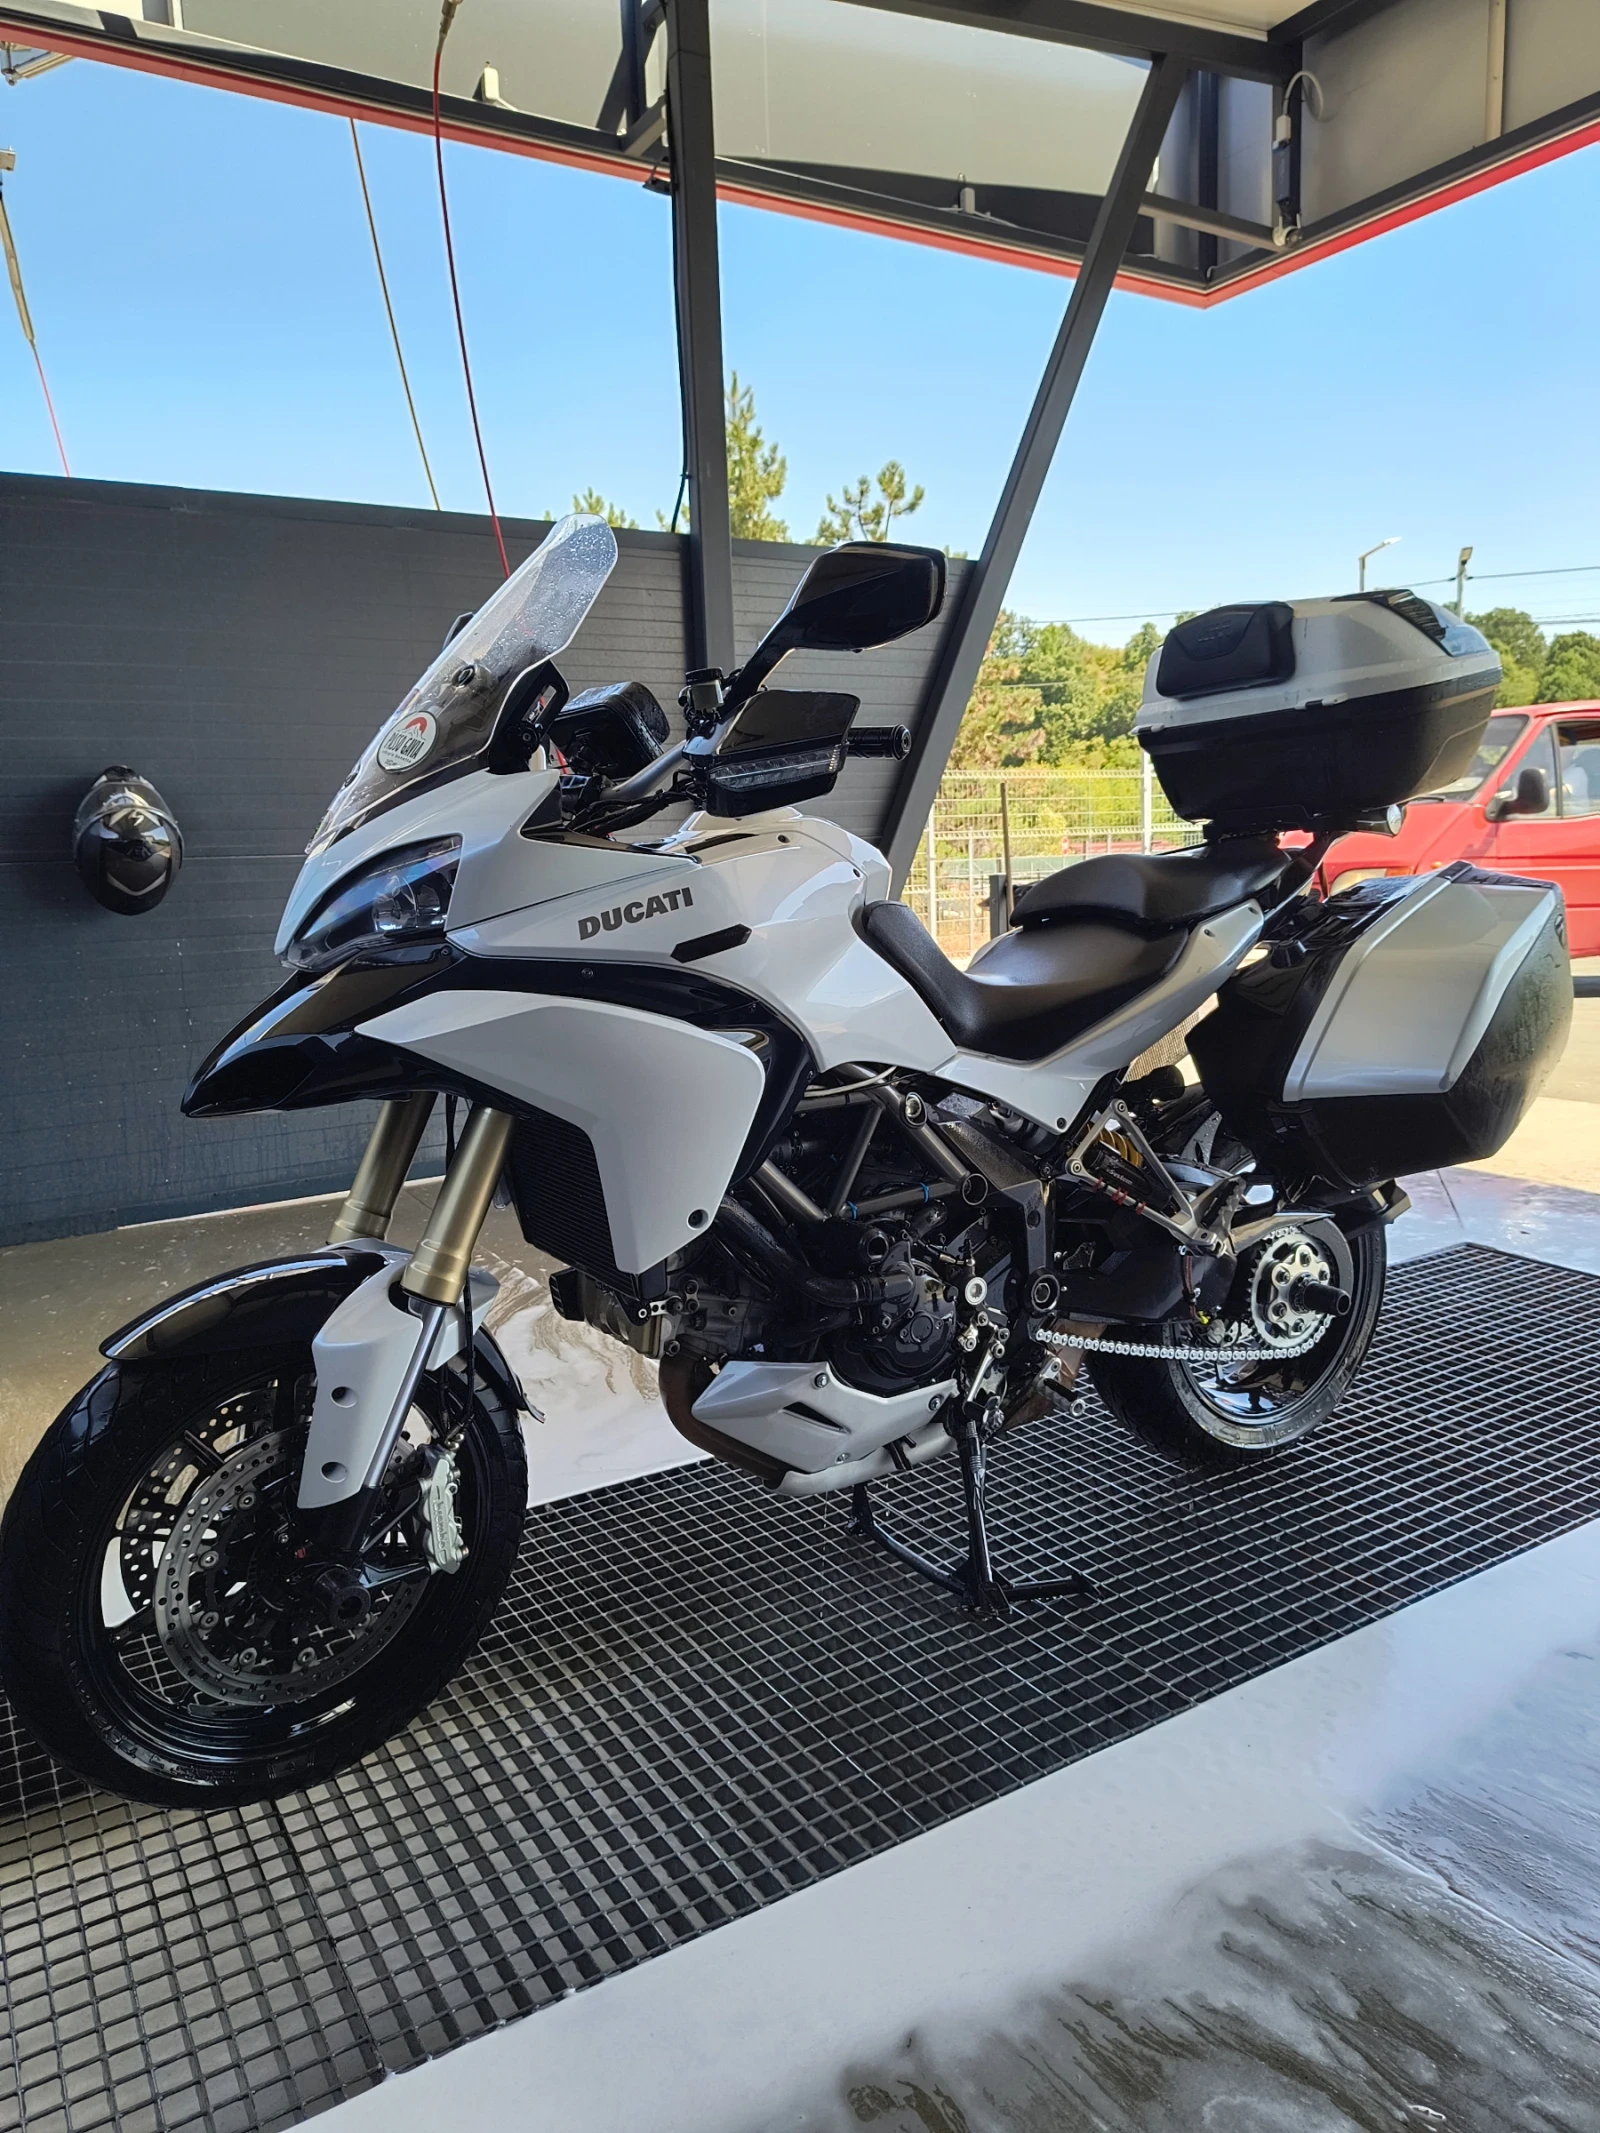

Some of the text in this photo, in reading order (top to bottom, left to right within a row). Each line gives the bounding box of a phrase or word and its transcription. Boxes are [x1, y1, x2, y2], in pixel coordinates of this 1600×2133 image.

[384, 732, 424, 759] PASSO GAVIA
[578, 887, 694, 940] DUCATI
[432, 1501, 446, 1549] brembo
